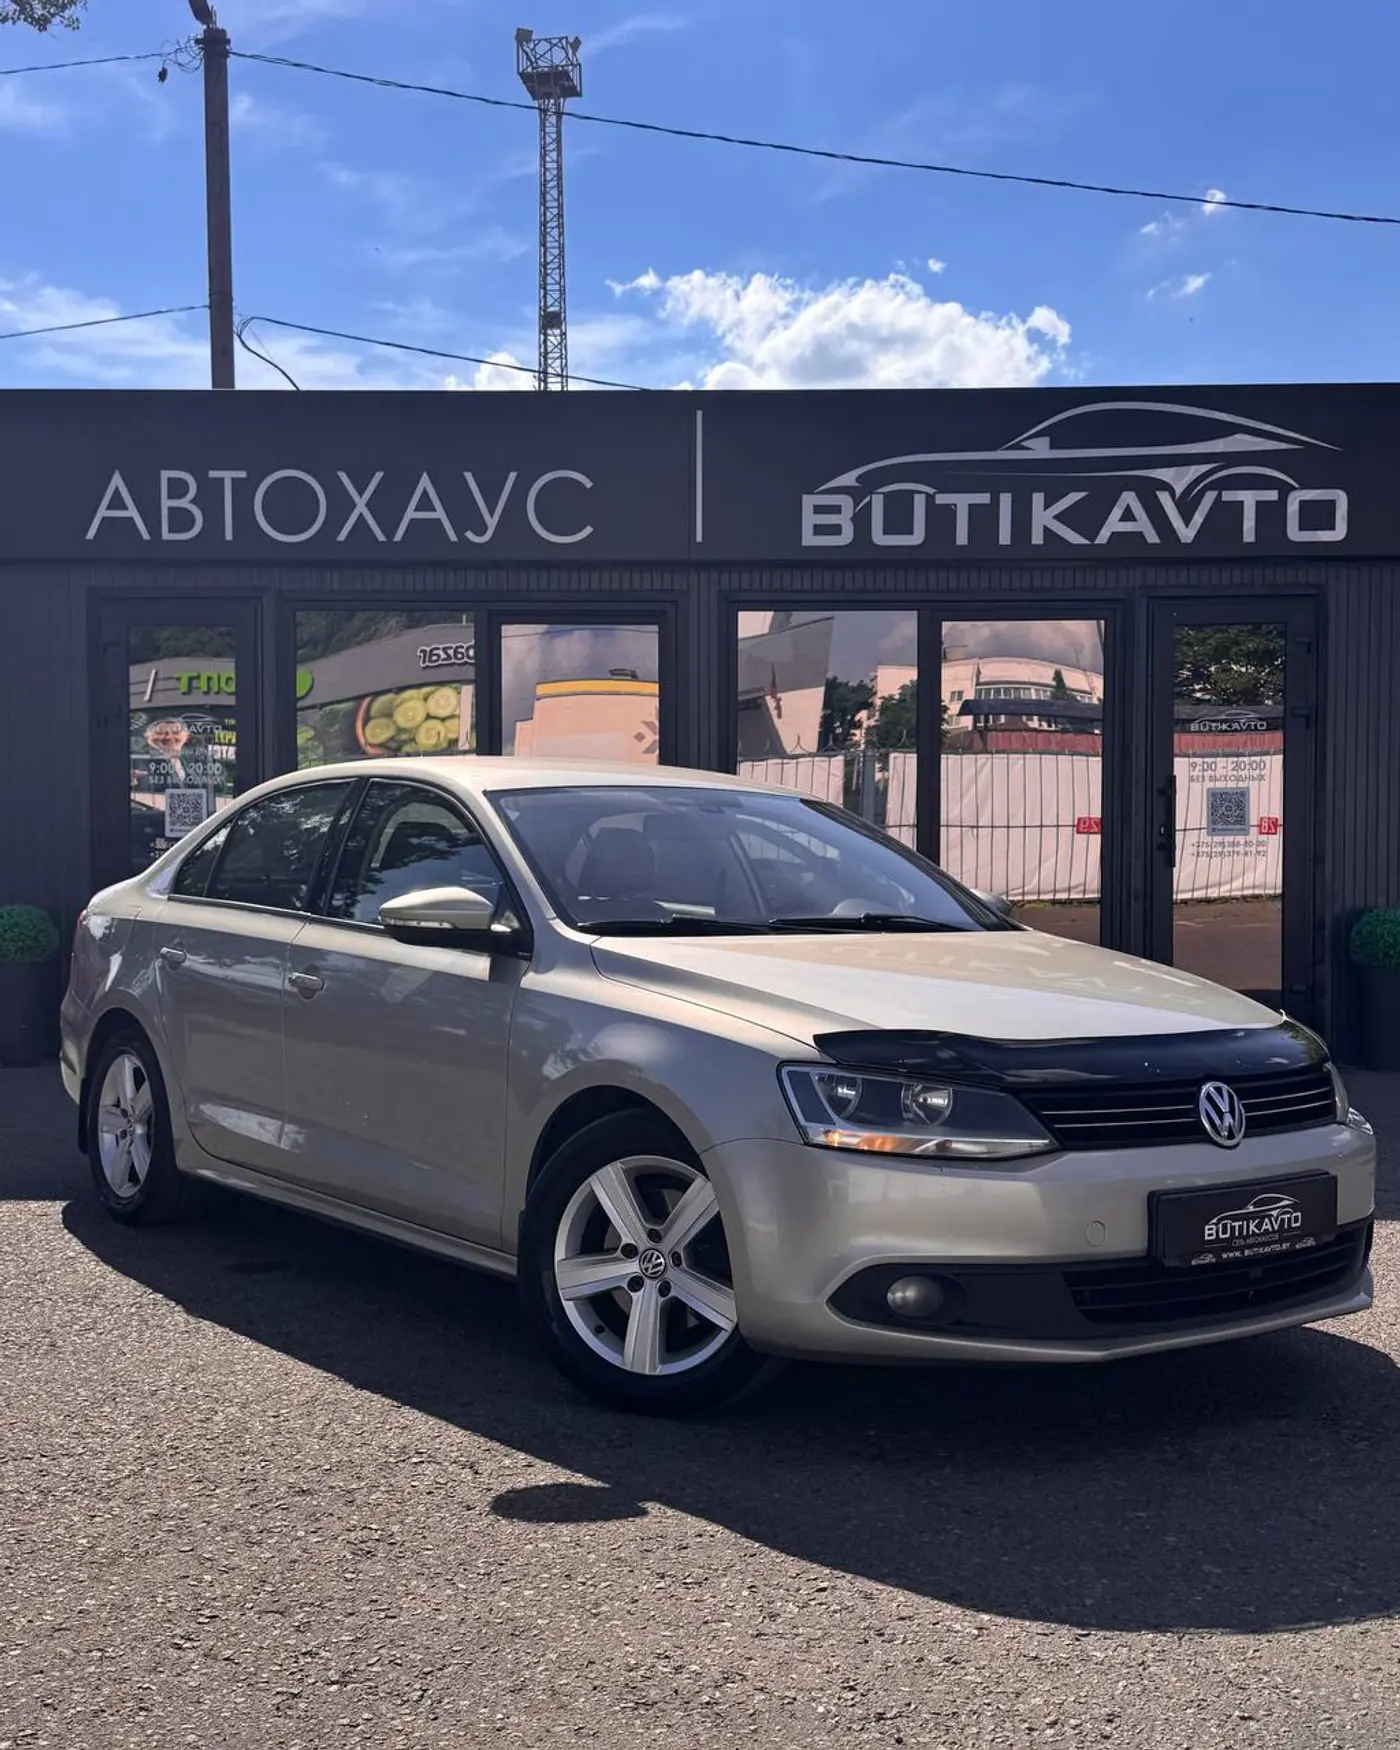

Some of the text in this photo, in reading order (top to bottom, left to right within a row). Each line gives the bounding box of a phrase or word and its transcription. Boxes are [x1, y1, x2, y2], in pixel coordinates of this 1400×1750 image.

[85, 469, 594, 544] АВТОХАУС
[801, 488, 1348, 546] BUTIKAVTO
[1190, 761, 1217, 772] 9:00
[1231, 760, 1266, 771] 20:00
[1204, 1211, 1302, 1241] BUTIKAVTO
